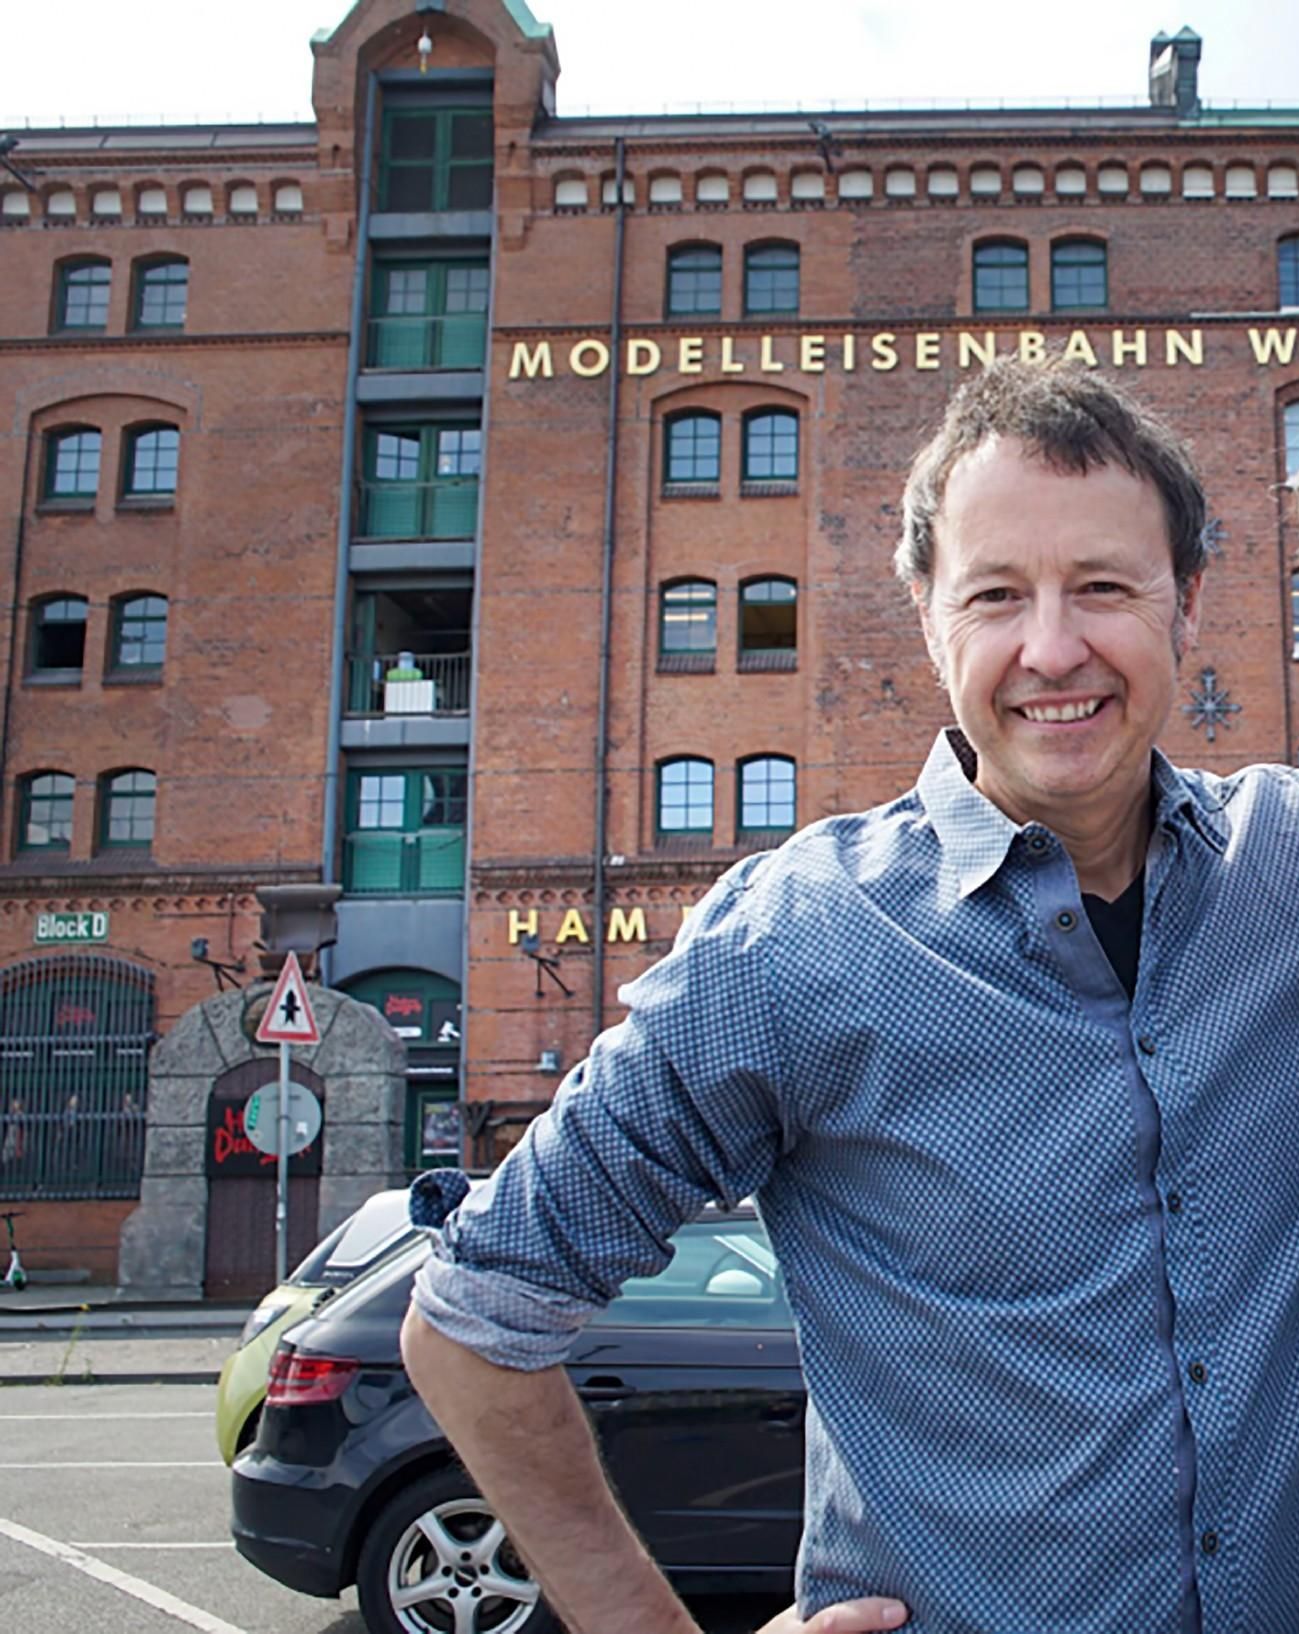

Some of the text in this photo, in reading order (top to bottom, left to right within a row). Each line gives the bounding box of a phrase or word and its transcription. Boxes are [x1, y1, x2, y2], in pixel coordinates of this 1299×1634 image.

[508, 329, 1204, 378] MODELLEISENBAHN
[37, 913, 106, 938] Block D
[508, 906, 695, 945] HAM
